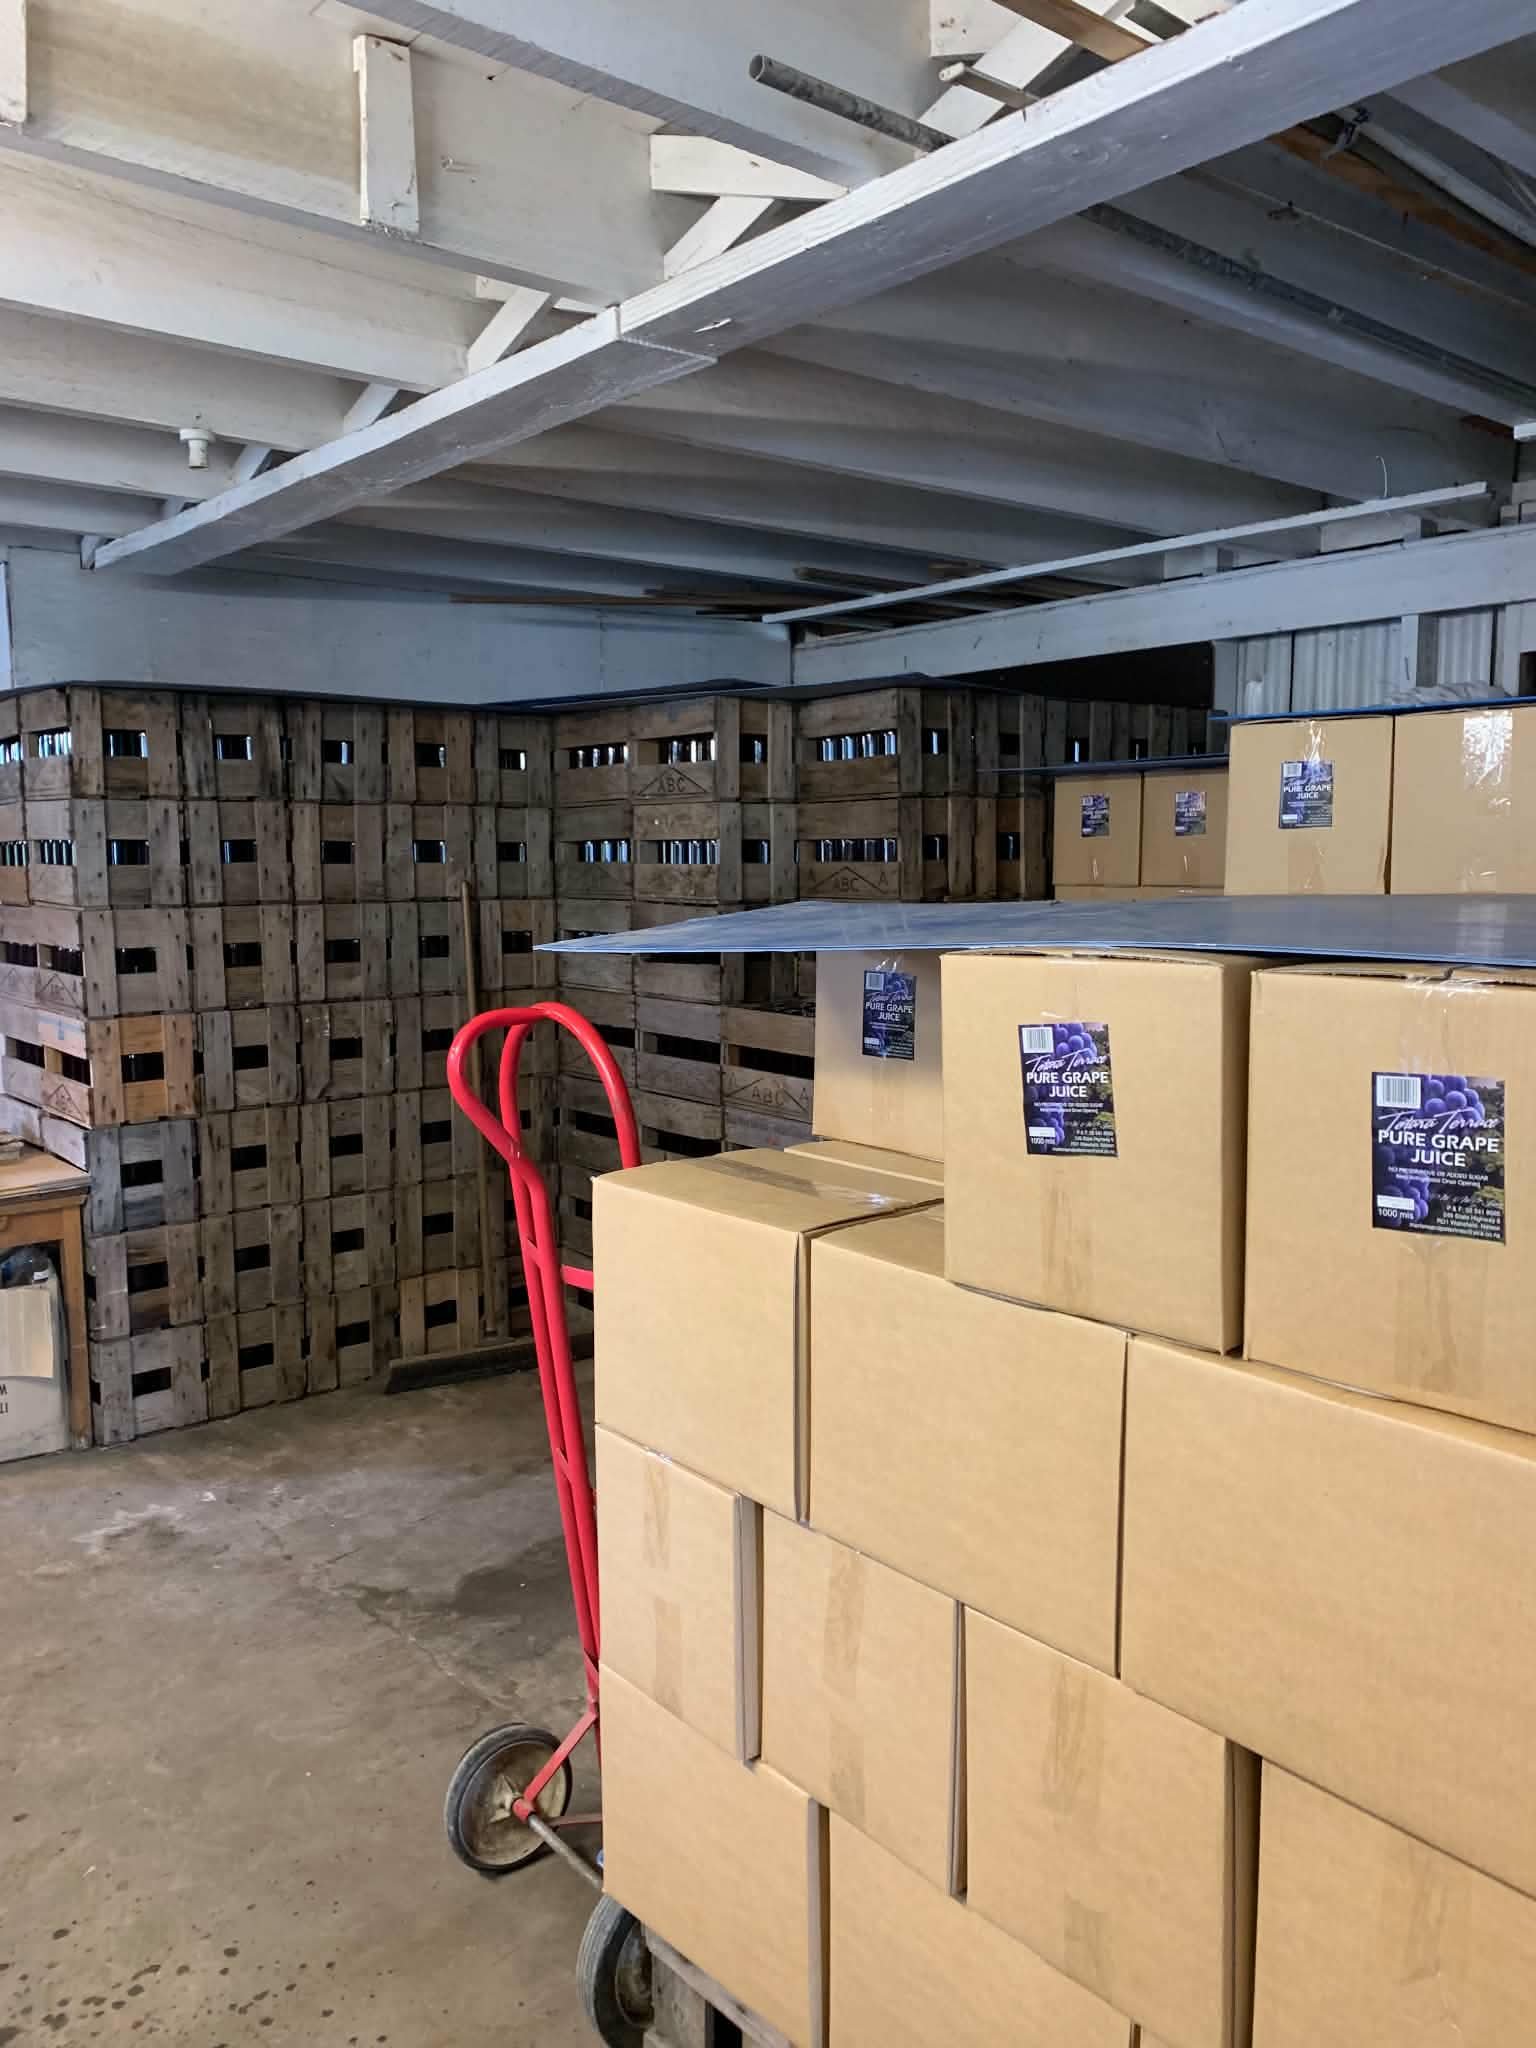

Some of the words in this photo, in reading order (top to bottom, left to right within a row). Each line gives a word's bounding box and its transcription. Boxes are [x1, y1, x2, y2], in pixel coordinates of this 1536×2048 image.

[657, 776, 687, 793] ABC
[1304, 784, 1333, 793] GRAPE
[865, 1001, 885, 1011] PURE
[886, 1003, 913, 1014] GRAPE
[878, 1011, 901, 1022] JUICE
[1026, 1071, 1059, 1084] PURE
[1062, 1071, 1109, 1084] GRAPE
[1049, 1085, 1088, 1098] JUICE
[1378, 1129, 1427, 1147] PURE
[1431, 1134, 1500, 1153] GRAPE
[1410, 1149, 1467, 1167] JUICE
[1379, 1207, 1398, 1218] 1000
